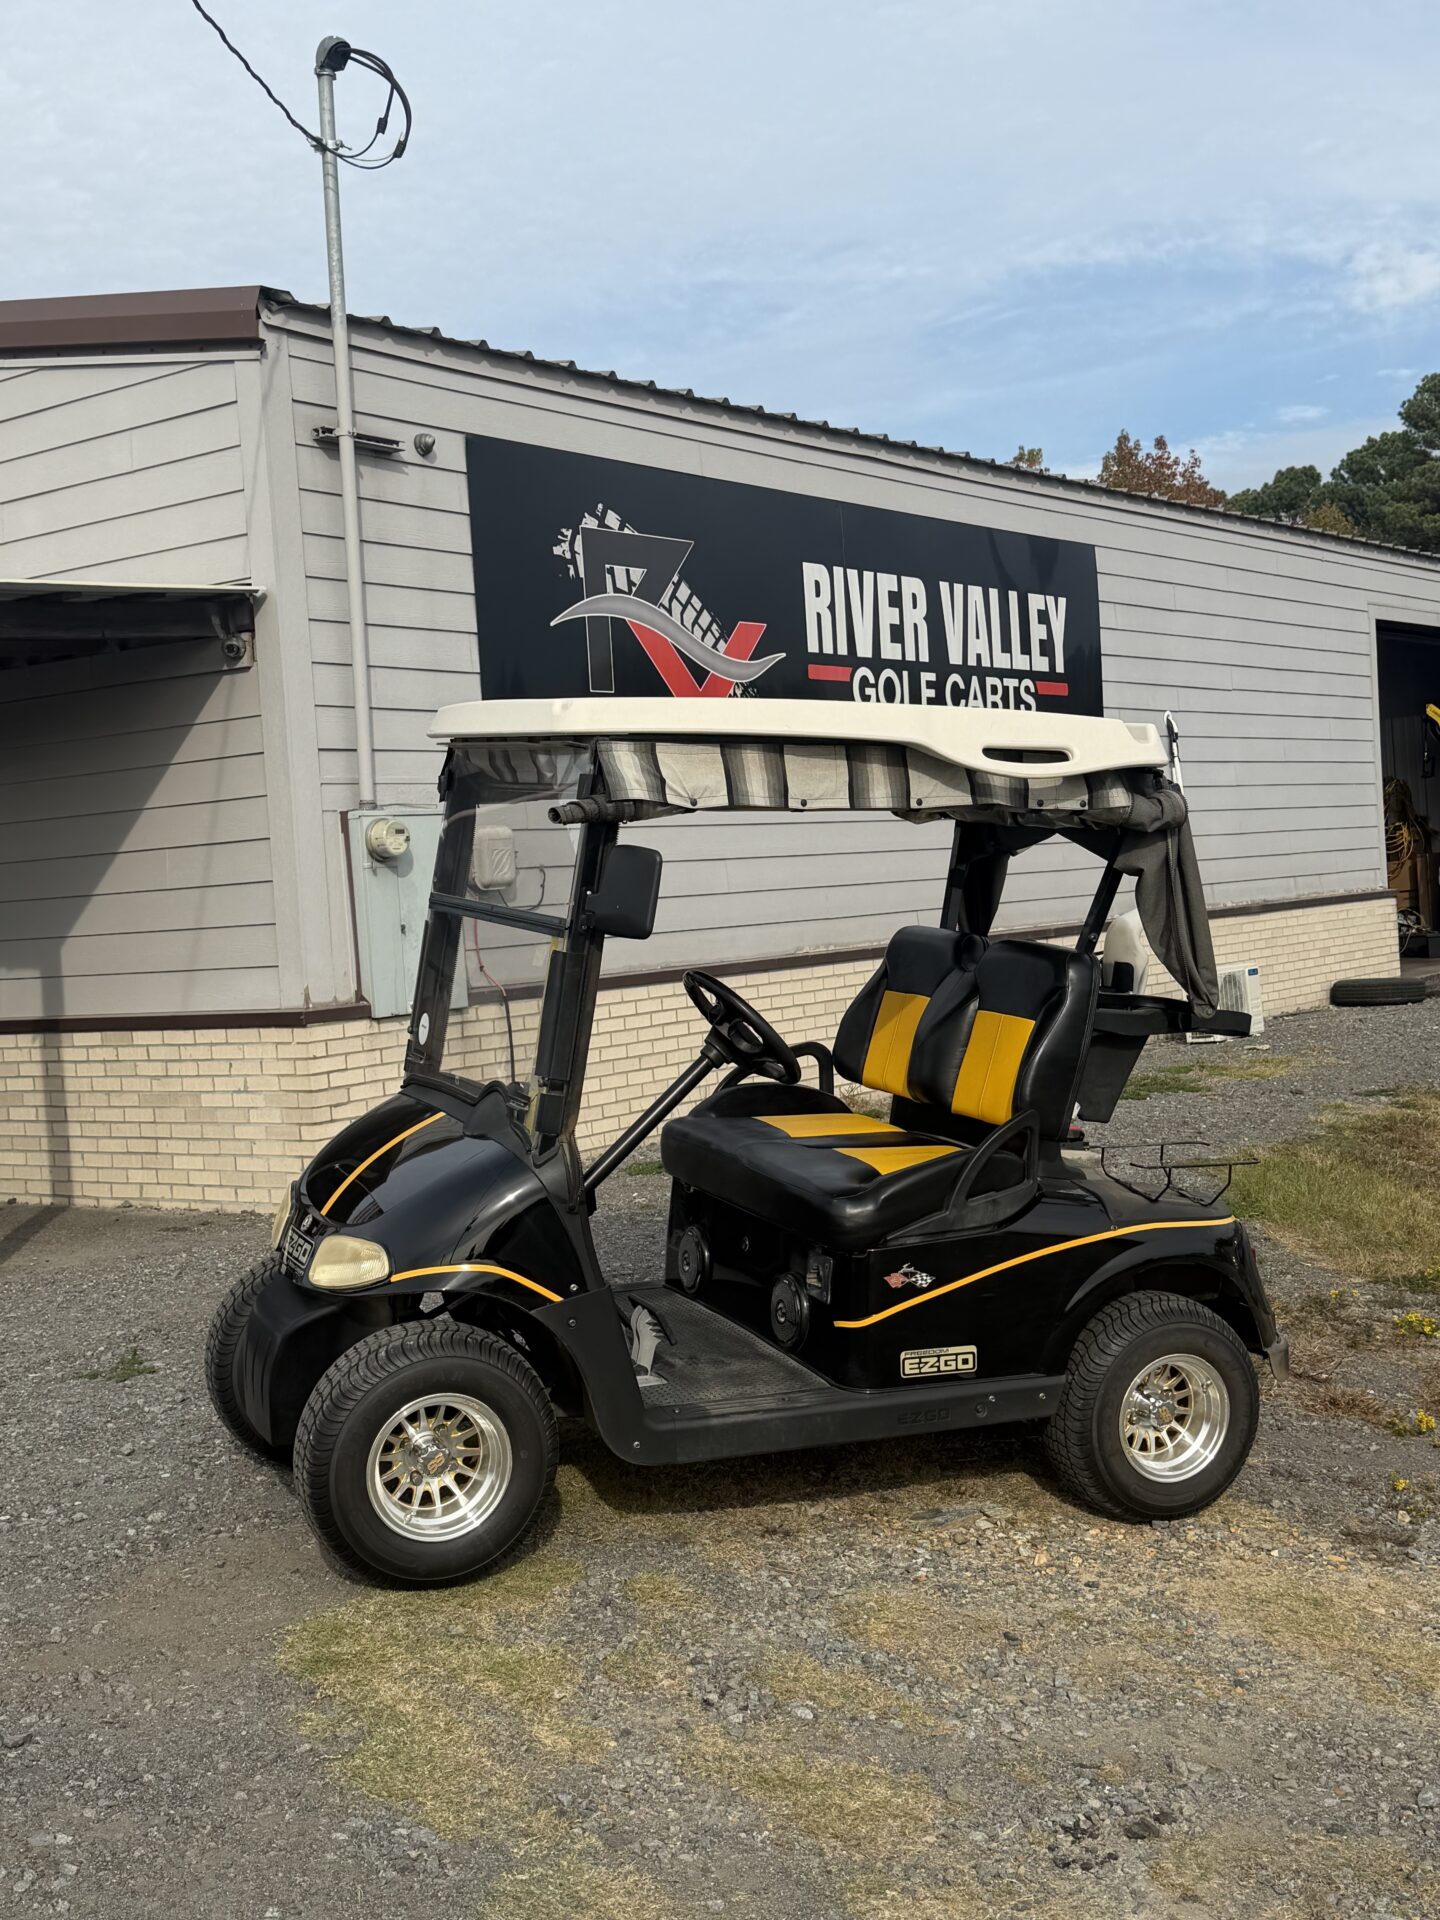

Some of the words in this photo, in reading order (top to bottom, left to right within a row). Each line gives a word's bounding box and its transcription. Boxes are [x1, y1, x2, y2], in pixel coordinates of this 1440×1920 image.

[802, 562, 929, 663] RIVER
[939, 581, 1067, 673] VALLEY
[853, 667, 937, 706] GOLF
[946, 673, 1037, 712] CARTS
